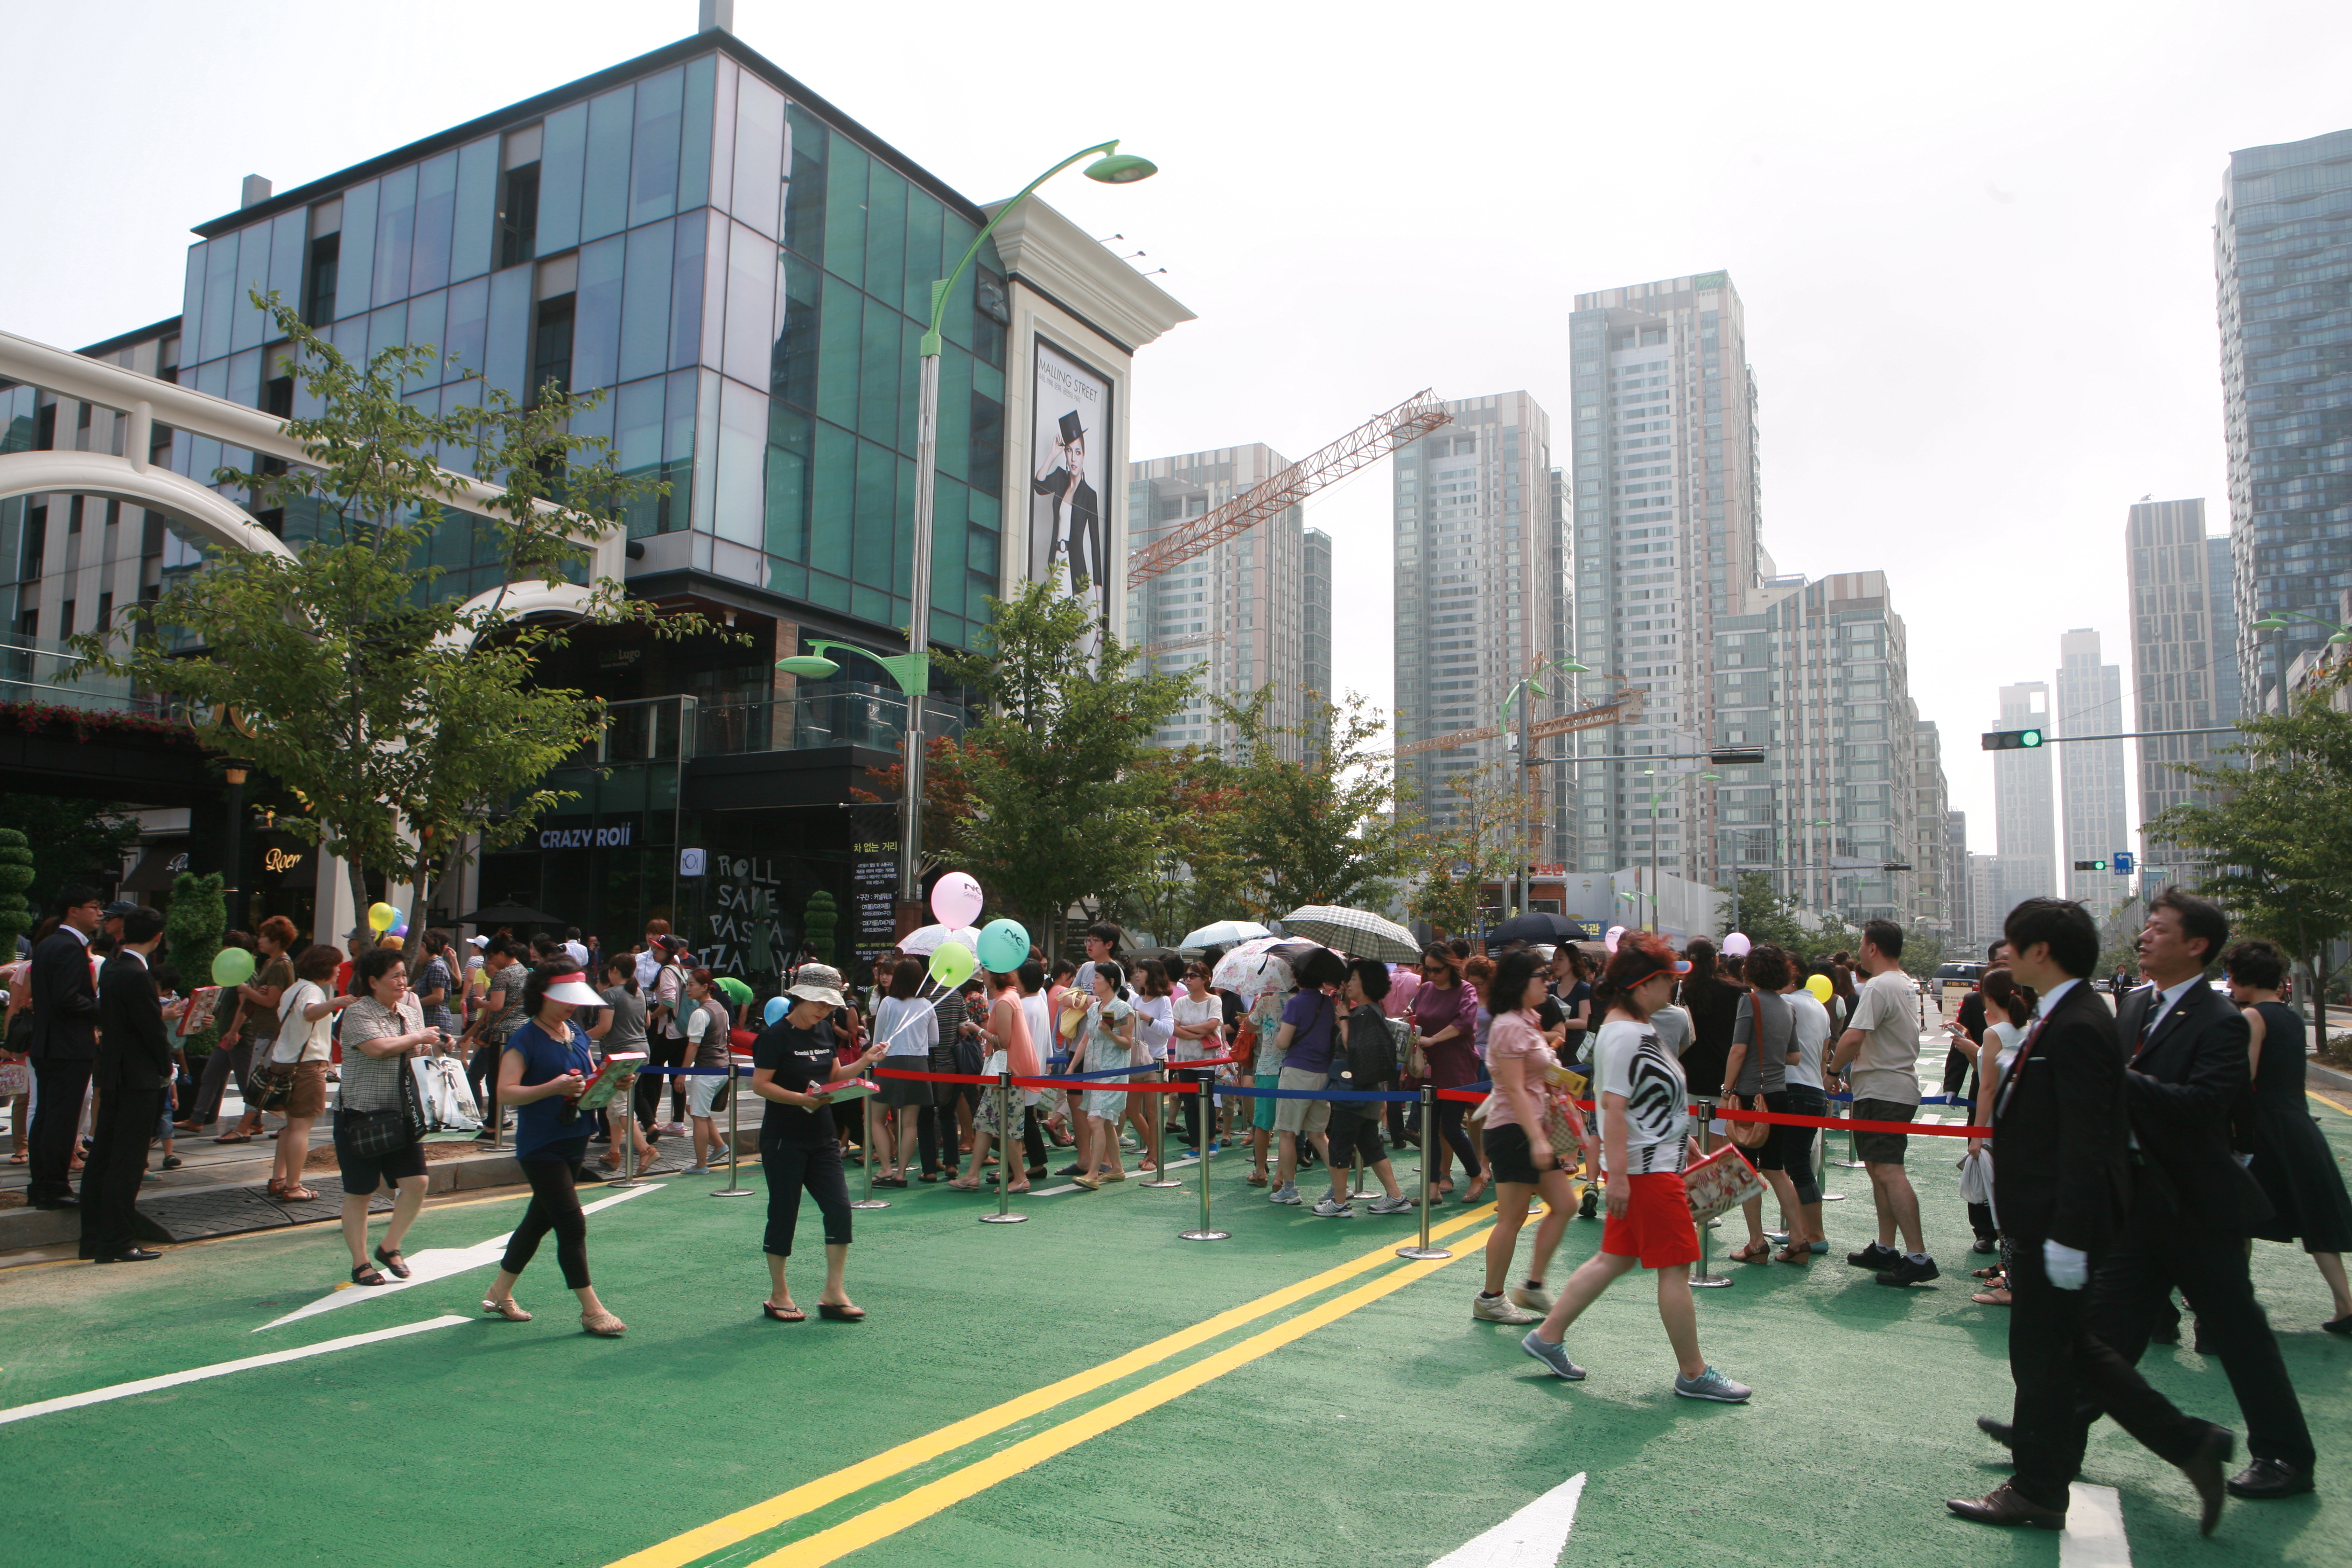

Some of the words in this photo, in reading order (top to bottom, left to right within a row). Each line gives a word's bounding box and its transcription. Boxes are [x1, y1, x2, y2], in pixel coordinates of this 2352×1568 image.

[1039, 358, 1072, 387] MALLING
[1074, 380, 1097, 403] STREET
[540, 830, 593, 849] CRAZY
[853, 843, 862, 853] 차
[864, 842, 879, 853] 없는
[882, 841, 897, 852] 거리
[718, 855, 781, 885] ROLL
[709, 914, 785, 946] PASA
